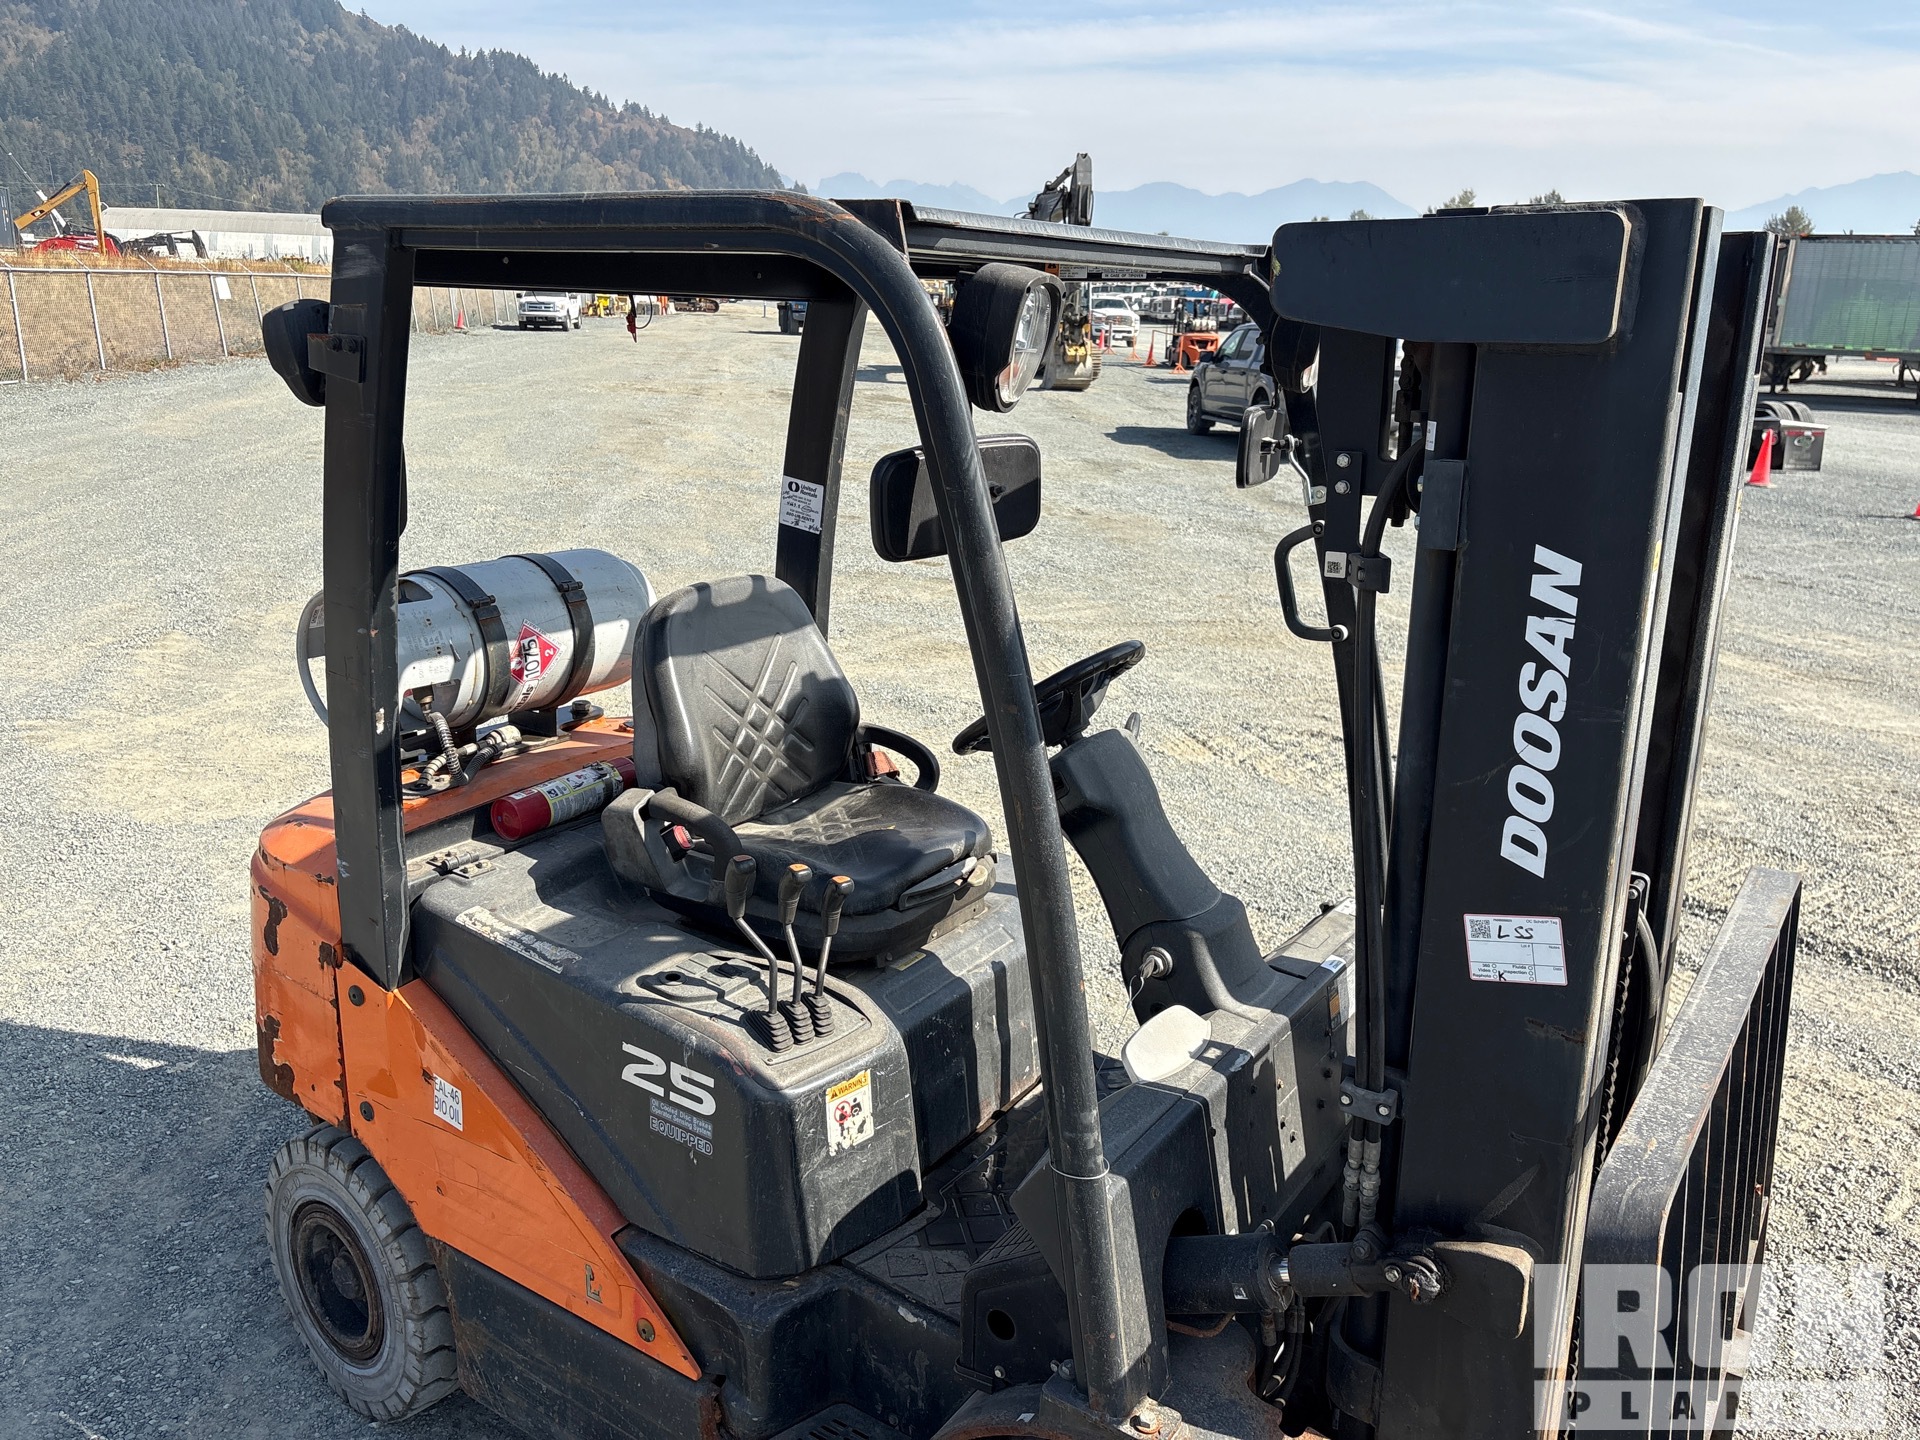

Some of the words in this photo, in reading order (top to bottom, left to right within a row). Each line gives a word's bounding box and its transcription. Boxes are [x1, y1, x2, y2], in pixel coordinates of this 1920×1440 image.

[800, 484, 817, 492] United
[800, 490, 818, 498] Rentals
[522, 639, 540, 679] 1075
[544, 647, 554, 657] 2
[1500, 543, 1583, 879] DOOSAN
[1497, 970, 1507, 981] K
[434, 1076, 460, 1105] EAL-46
[620, 1041, 717, 1116] 25
[434, 1094, 448, 1115] BIO
[448, 1105, 462, 1126] OIL
[651, 1098, 659, 1106] Oil
[660, 1102, 678, 1116] Cooled
[679, 1109, 692, 1121] Disc
[692, 1116, 712, 1131] Brakes
[651, 1105, 672, 1119] Operator
[672, 1114, 693, 1130] Sensing
[692, 1124, 712, 1136] System
[649, 1115, 714, 1156] EQUIPPED
